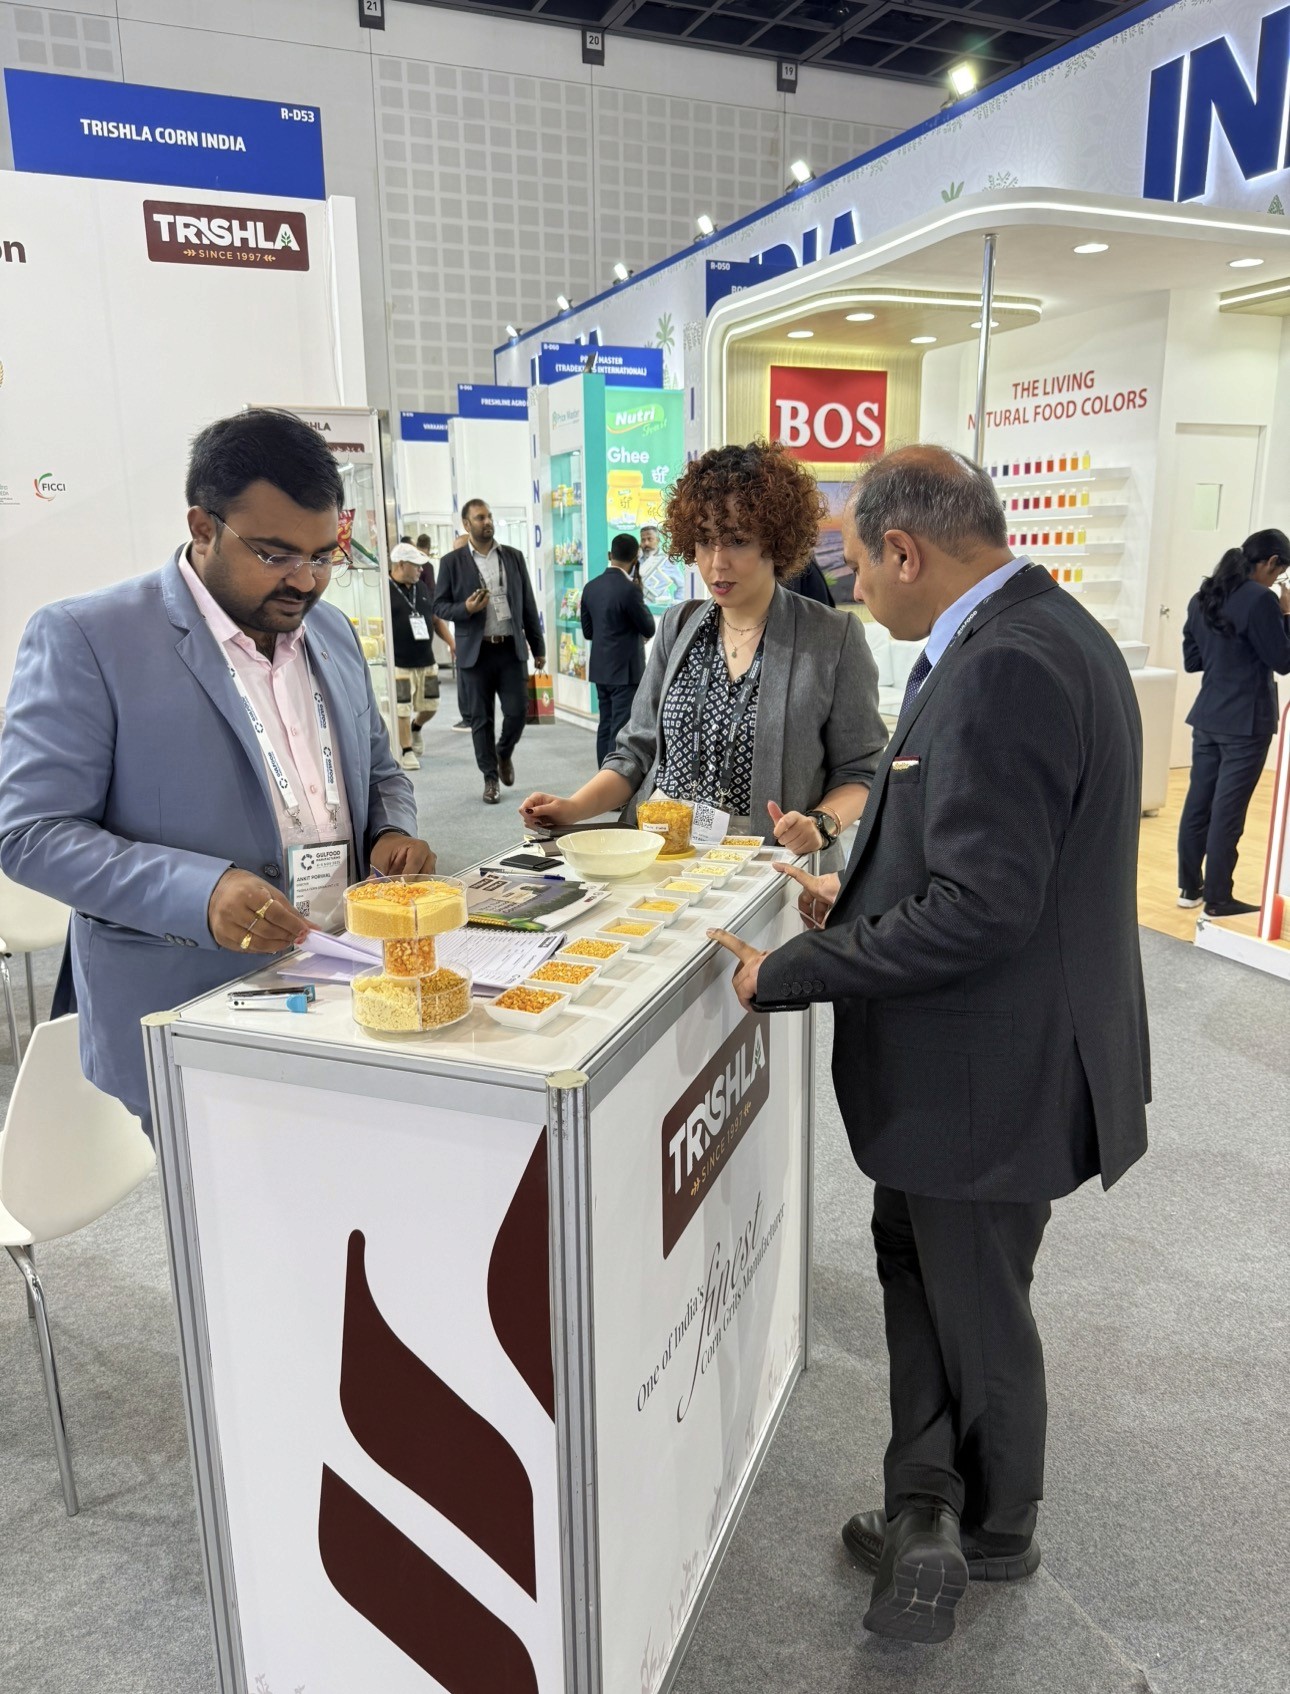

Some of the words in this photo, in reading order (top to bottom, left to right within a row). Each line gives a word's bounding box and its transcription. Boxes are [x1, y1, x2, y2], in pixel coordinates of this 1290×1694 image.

[366, 1, 378, 11] 21
[589, 35, 599, 45] 20
[785, 66, 793, 75] 19
[1143, 5, 1290, 203] IN
[281, 108, 314, 122] R-D53
[80, 118, 153, 142] TRISHLA
[155, 127, 198, 147] CORN
[201, 132, 246, 152] INDIA
[153, 214, 300, 251] TRISHLA
[199, 250, 233, 260] SINCE
[237, 252, 261, 261] 1997
[711, 262, 730, 271] R-D50
[600, 356, 623, 365] MASTER
[598, 365, 647, 377] INTERNATIONAL)
[1012, 379, 1039, 400] THE
[1042, 370, 1095, 396] LIVING
[481, 398, 510, 407] FRESHLINE
[511, 399, 526, 407] AGRO
[968, 408, 1029, 430] NTURAL
[1033, 400, 1076, 423] FOOD
[1081, 388, 1148, 416] COLORS
[615, 406, 655, 426] Nutri
[775, 399, 881, 449] BOS
[607, 447, 649, 463] Ghee
[42, 483, 65, 491] FICCI
[316, 850, 341, 858] GULFOOD
[669, 1023, 766, 1195] TRISHLA
[702, 1138, 725, 1183] SINCE
[727, 1110, 743, 1144] 1997
[701, 1328, 722, 1375] Corn
[723, 1286, 742, 1332] Grits
[742, 1202, 786, 1290] Manufacturer
[676, 1190, 764, 1423] finest
[637, 1363, 660, 1412] One
[662, 1332, 674, 1370] of
[674, 1284, 705, 1350] India's
